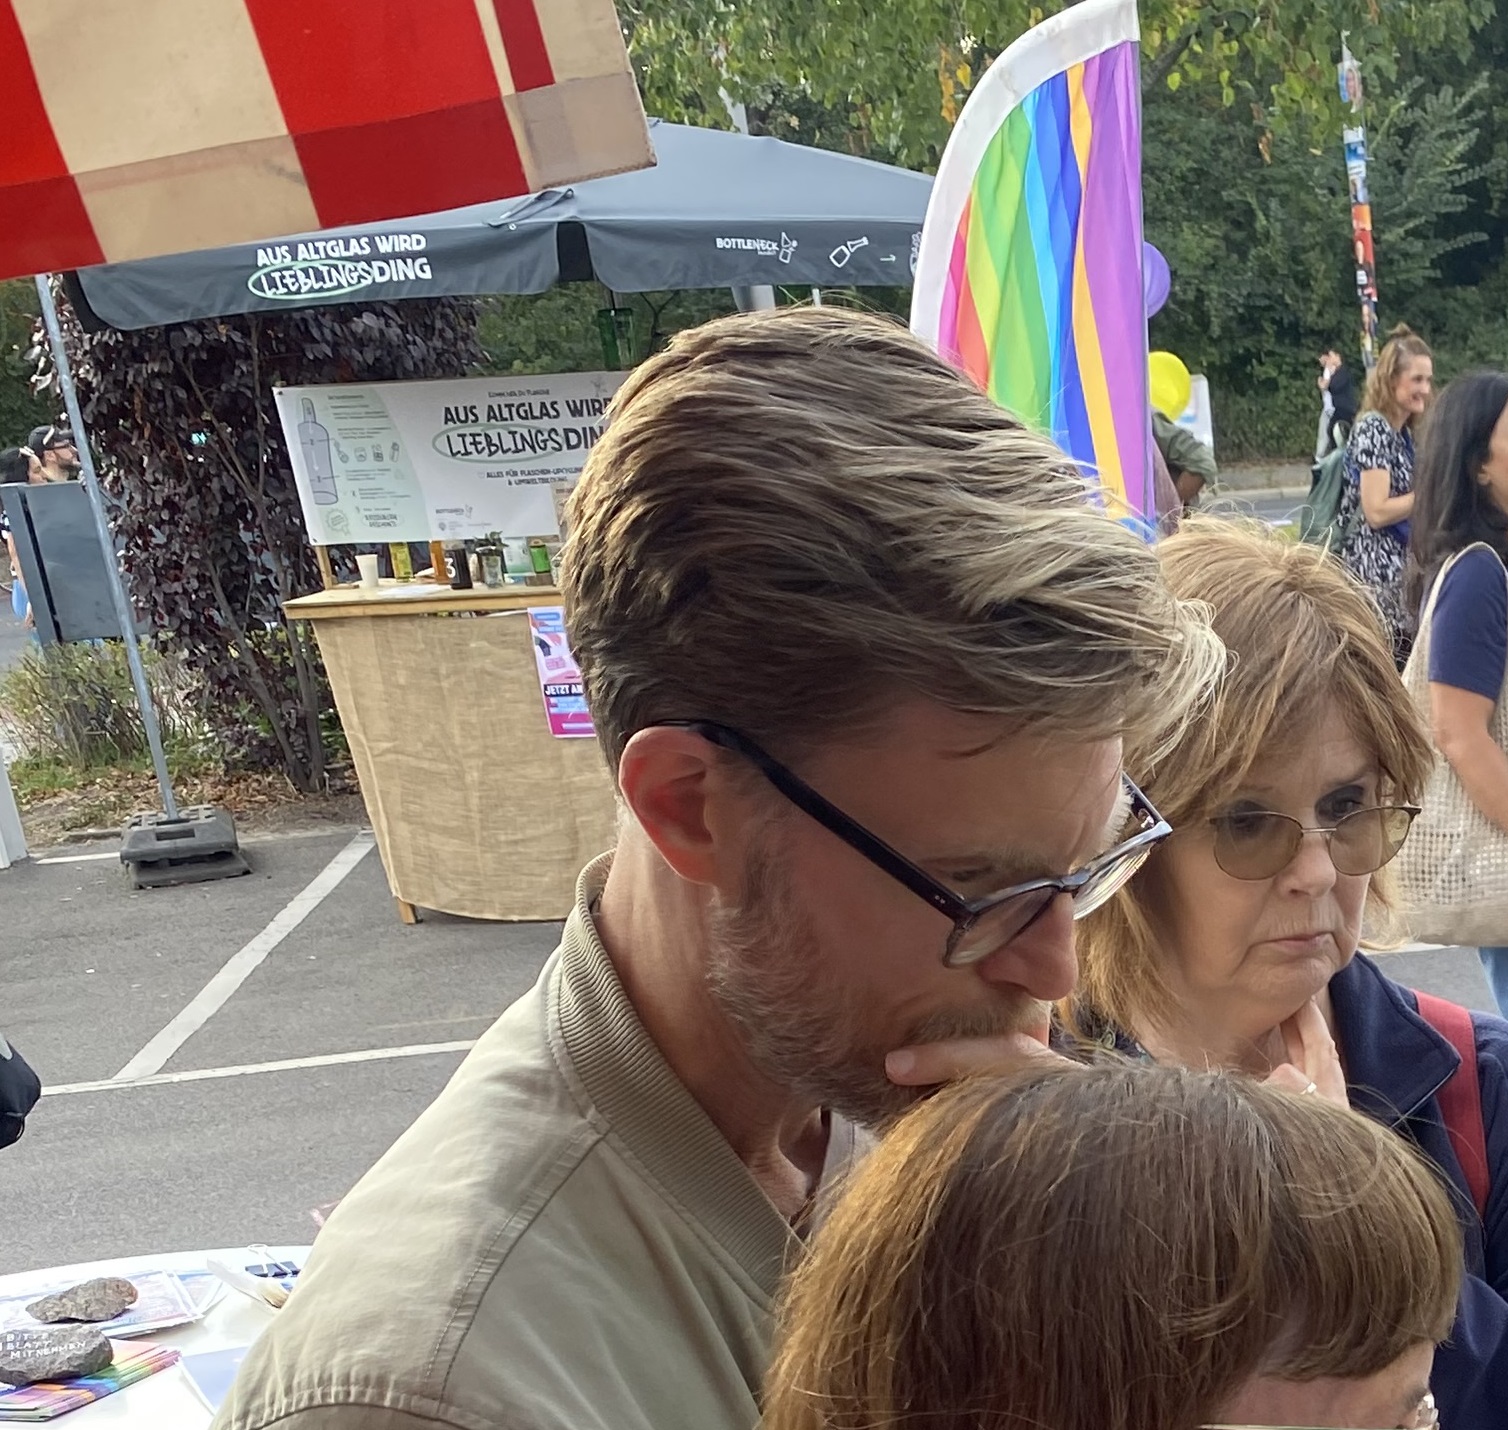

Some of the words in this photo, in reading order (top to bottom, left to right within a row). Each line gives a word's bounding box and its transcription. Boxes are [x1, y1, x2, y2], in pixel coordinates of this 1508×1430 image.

[257, 245, 292, 267] AUS
[297, 236, 371, 261] ALTGLAS
[374, 234, 427, 253] WIRD
[715, 237, 780, 251] BOTTLENECK
[260, 257, 433, 296] LIEBLINGSDING
[444, 406, 479, 425] AUS
[486, 400, 560, 423] ALTGLAS
[444, 557, 456, 578] 3
[545, 684, 569, 696] JETZT
